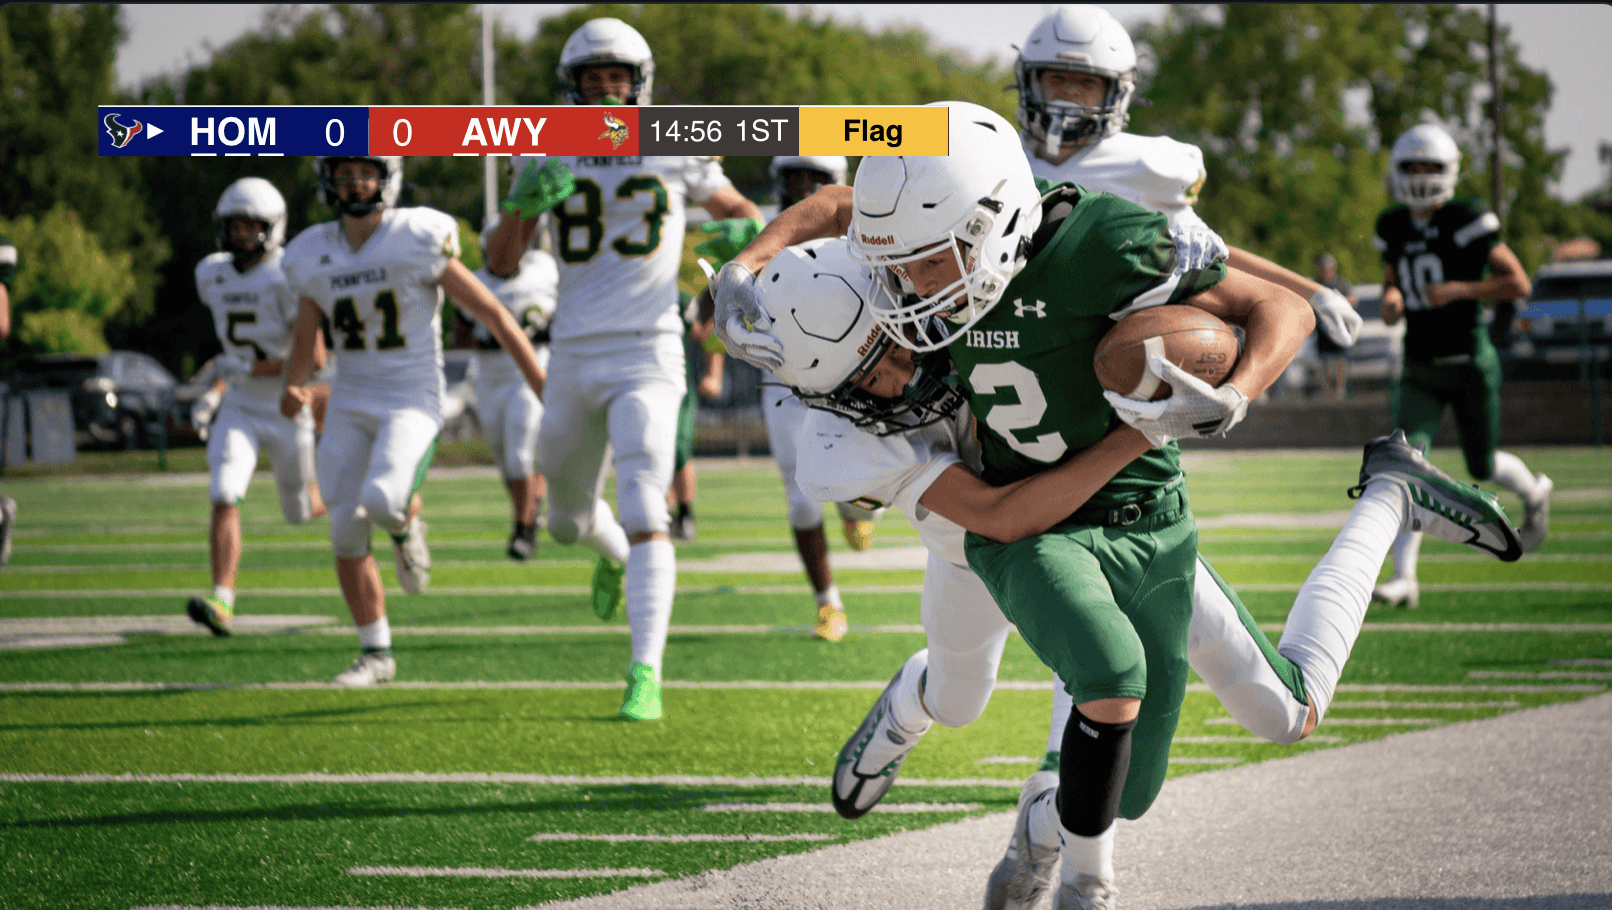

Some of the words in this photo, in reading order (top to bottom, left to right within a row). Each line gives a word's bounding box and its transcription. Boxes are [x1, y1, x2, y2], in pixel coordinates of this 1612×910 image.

[553, 175, 671, 264] 83
[861, 234, 895, 245] Riddell
[1398, 253, 1444, 311] 10
[227, 311, 267, 361] 5
[333, 289, 406, 351] 41
[857, 323, 883, 357] Ridde
[966, 330, 1020, 349] IRISH
[968, 360, 1069, 463] 2
